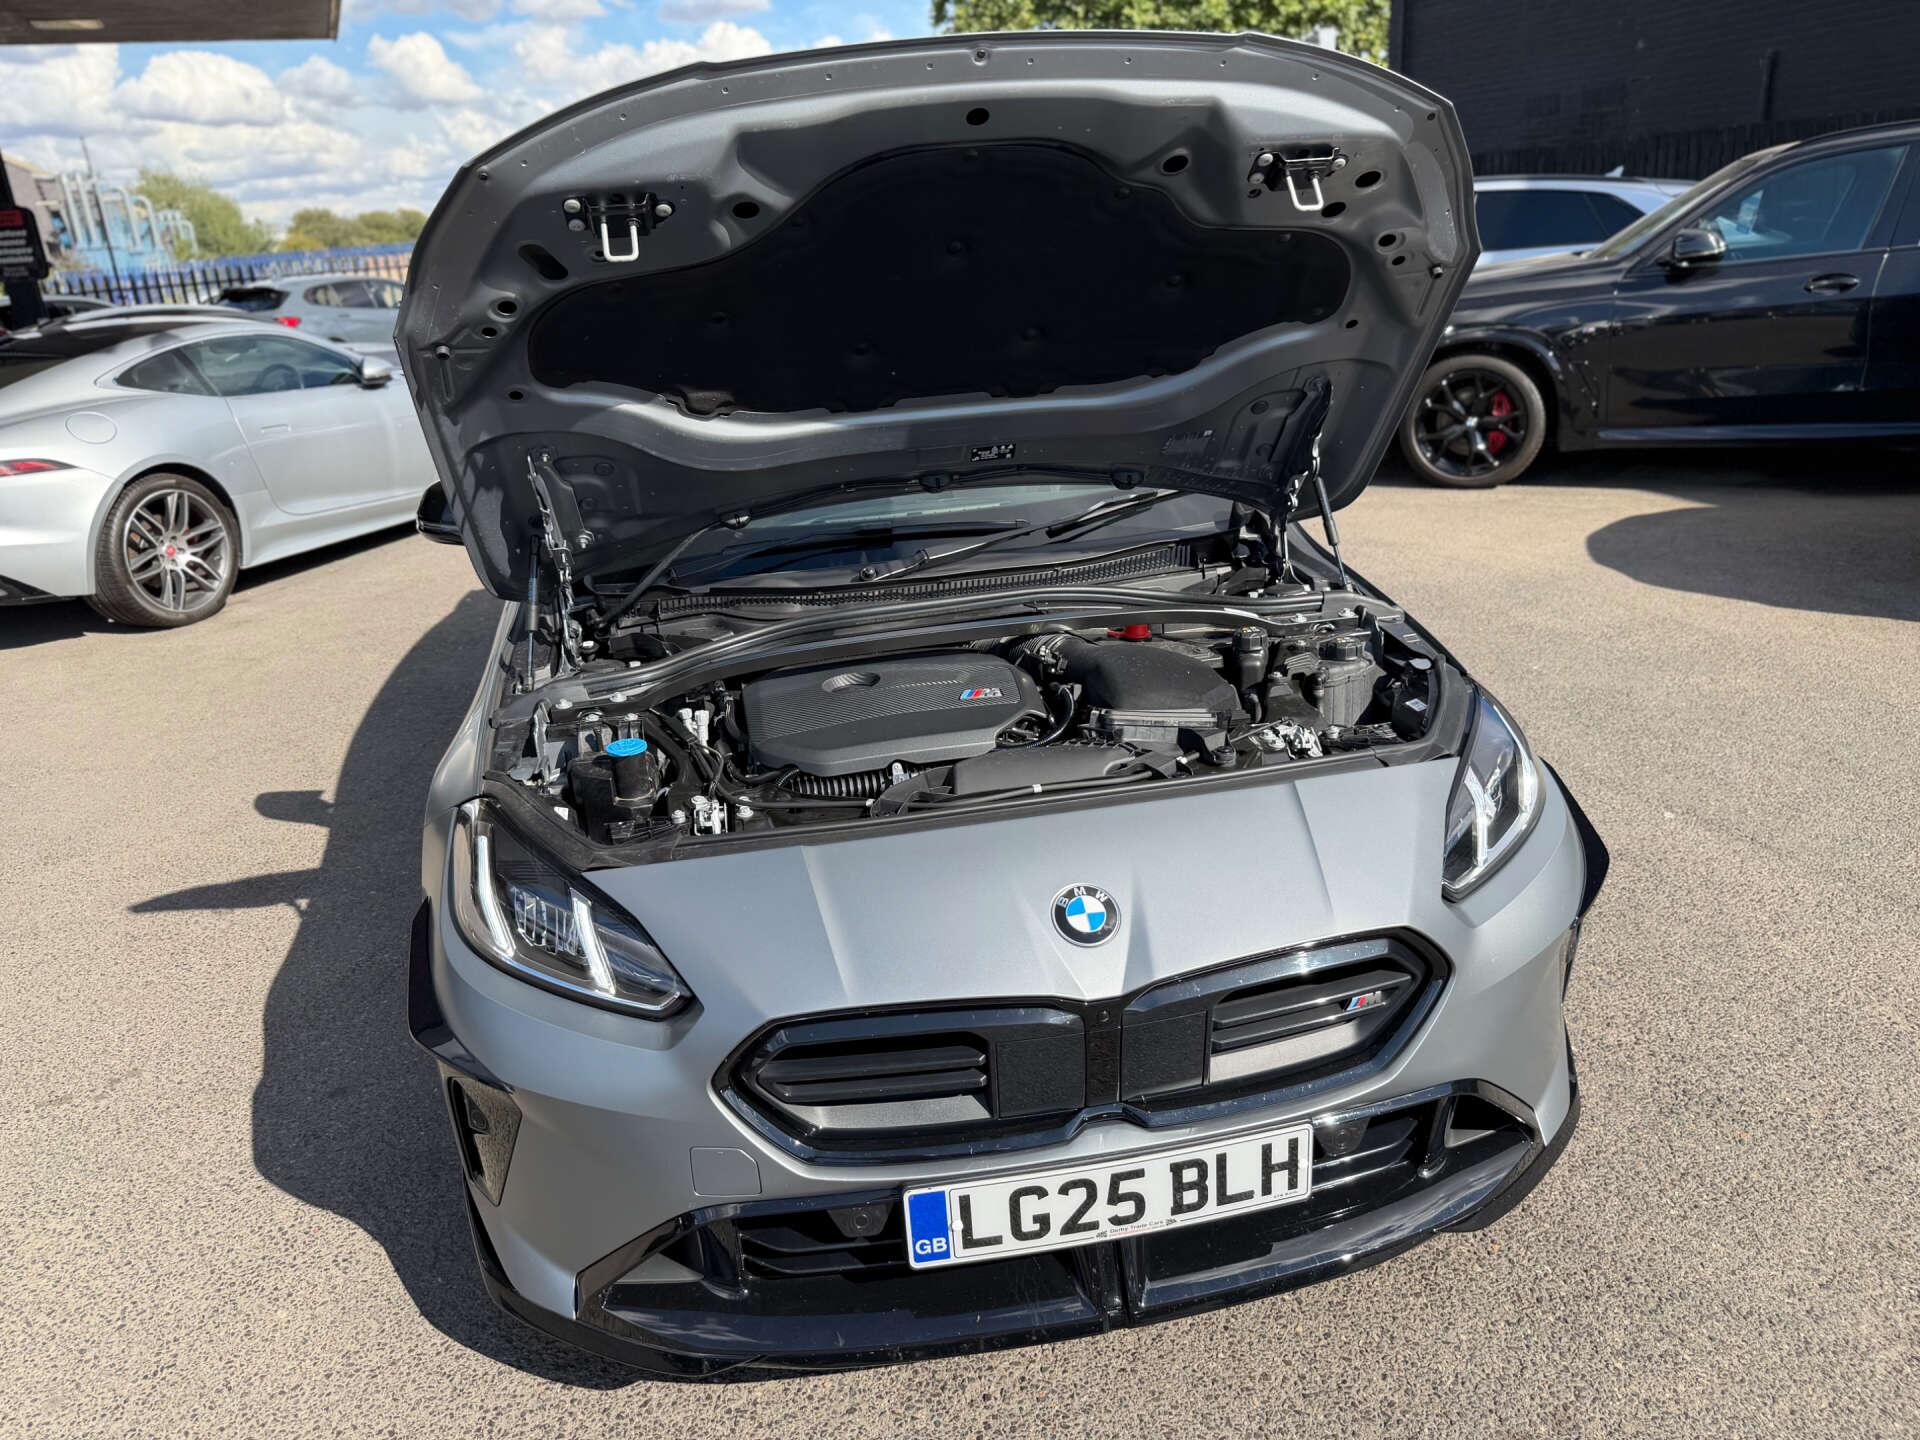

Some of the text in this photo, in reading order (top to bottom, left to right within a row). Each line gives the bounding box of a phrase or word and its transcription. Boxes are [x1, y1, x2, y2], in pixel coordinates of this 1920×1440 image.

[1055, 886, 1109, 908] BMW
[958, 1136, 1299, 1250] LG25 BLH
[915, 1237, 947, 1255] GB
